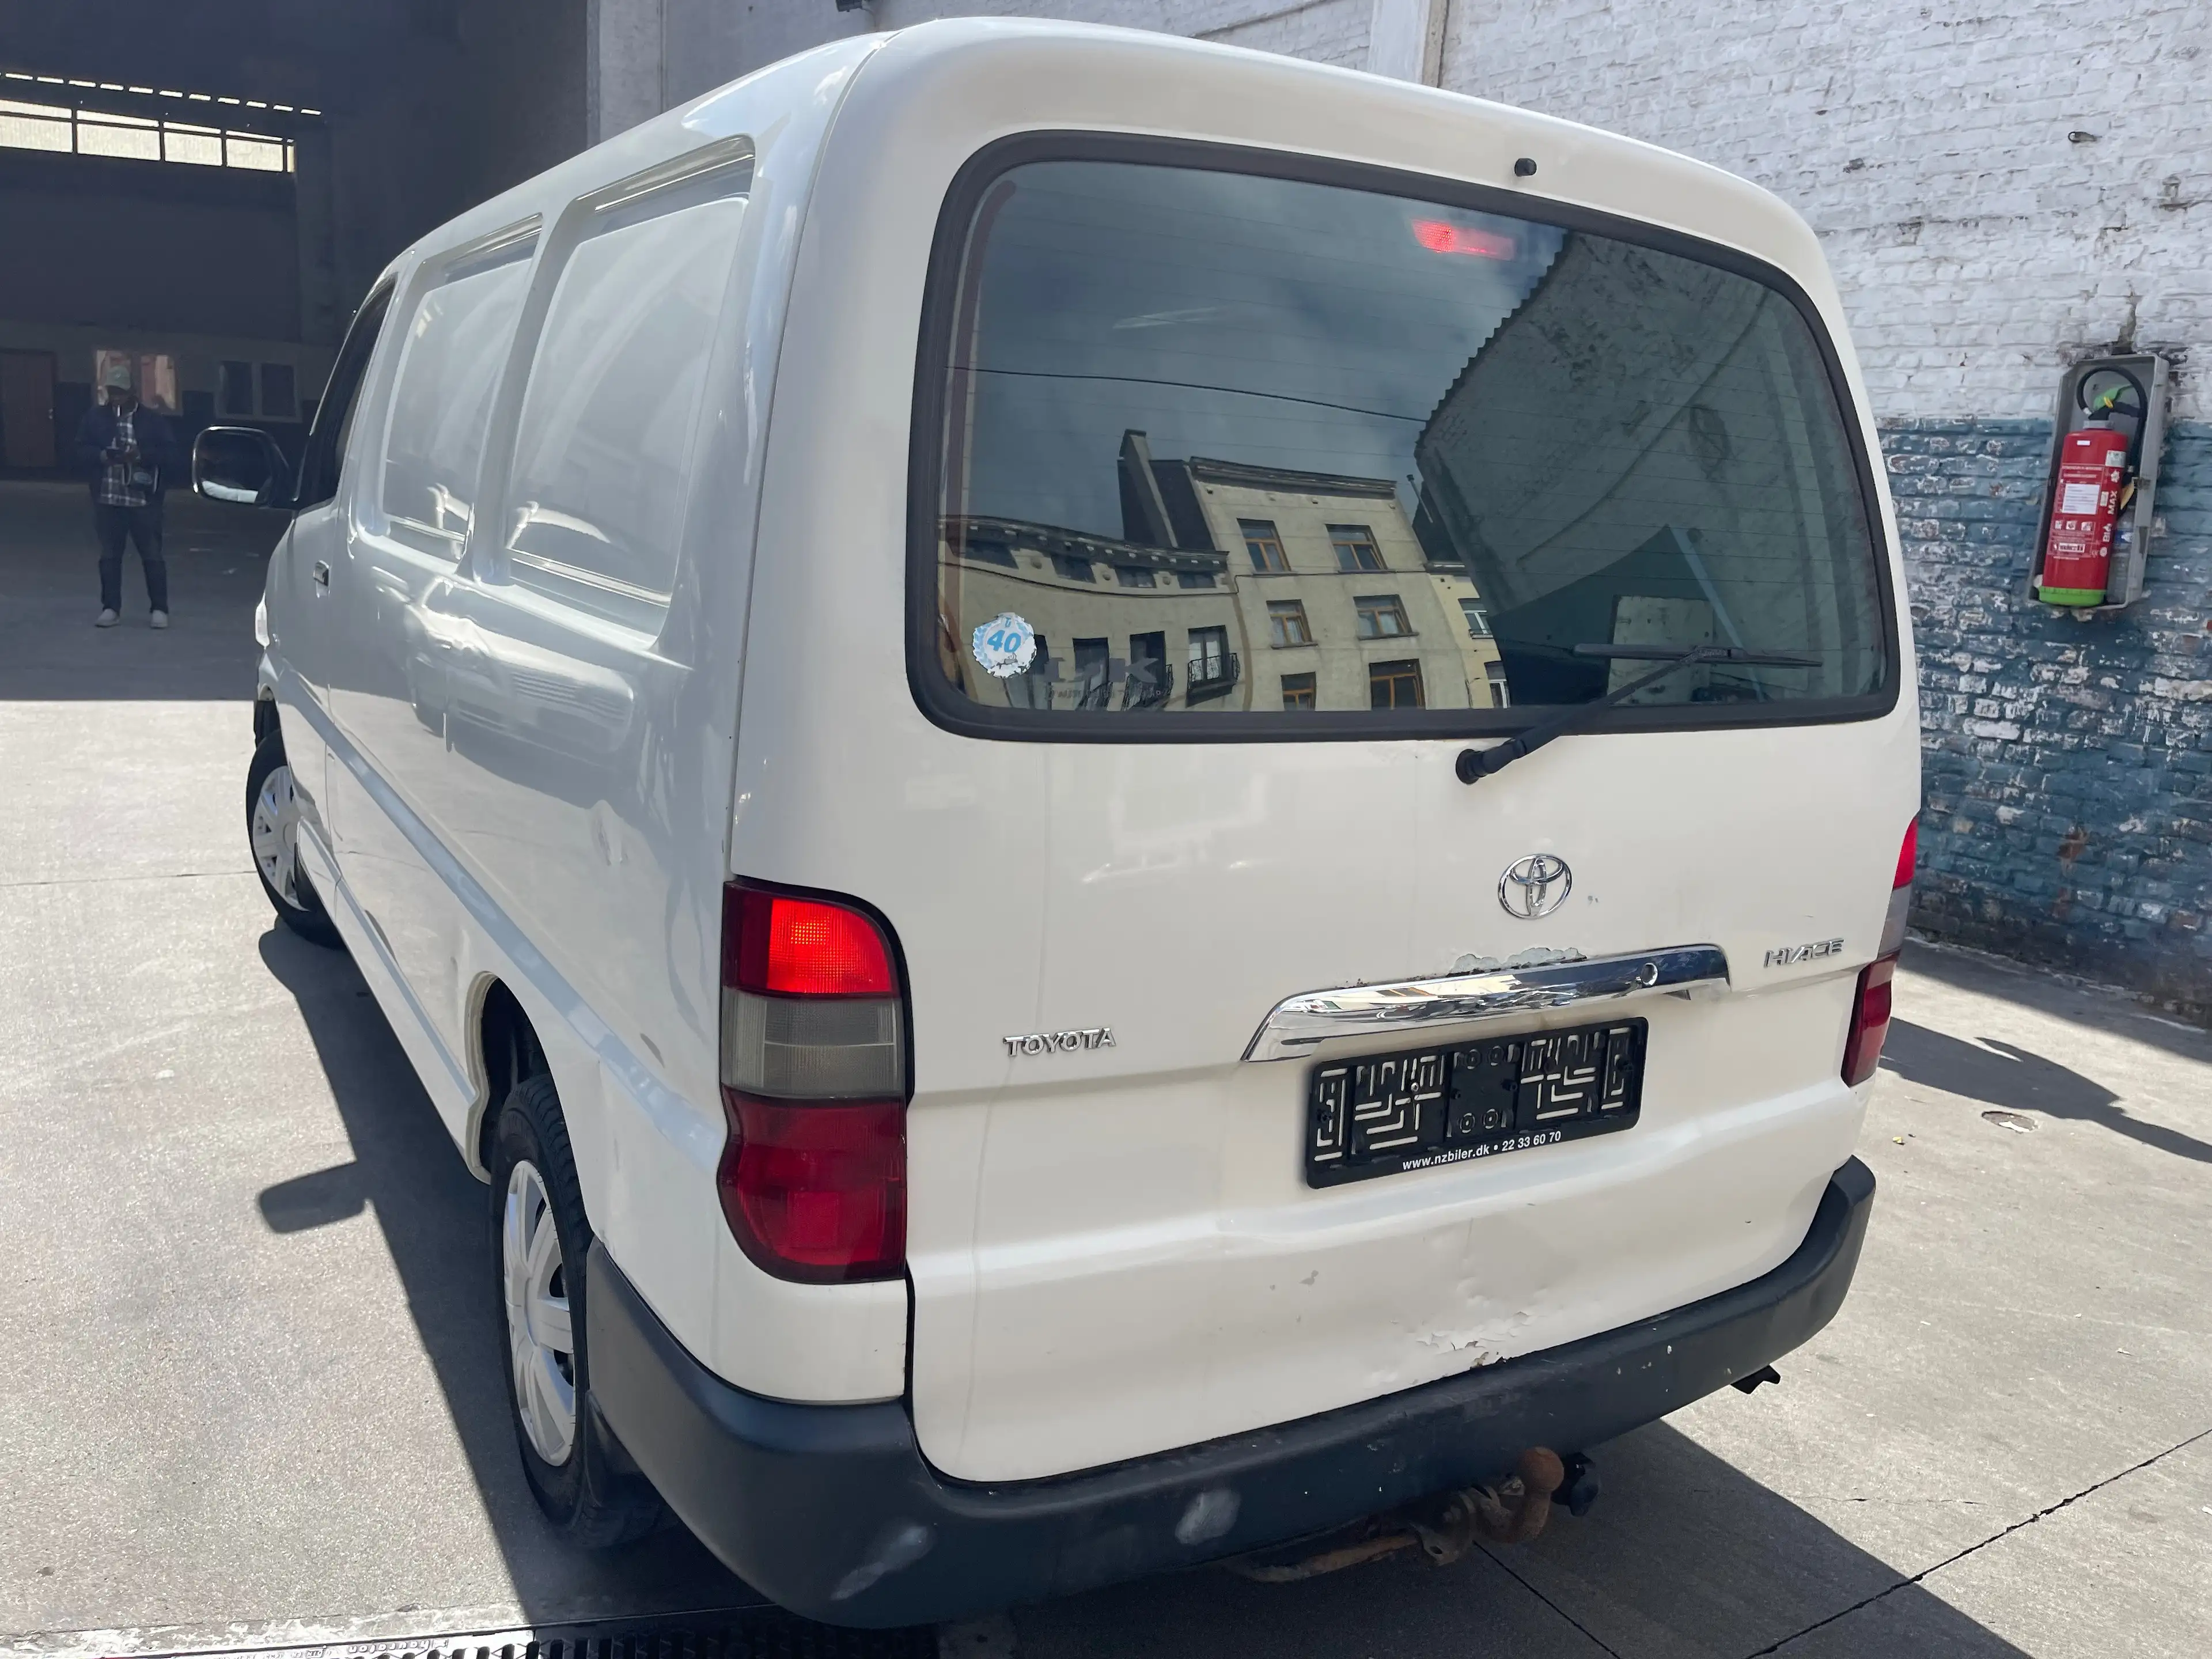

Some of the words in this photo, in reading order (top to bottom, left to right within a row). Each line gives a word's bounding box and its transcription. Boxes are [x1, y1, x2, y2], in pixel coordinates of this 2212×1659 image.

[987, 630, 1021, 653] 40
[1763, 938, 1844, 968] HIACE
[1002, 1027, 1116, 1056] TOYOTA
[1402, 1144, 1490, 1170] www.nzbiler.dk
[1502, 1139, 1515, 1152] 22
[1517, 1136, 1531, 1148] 33
[1533, 1133, 1546, 1146] 60
[1549, 1130, 1562, 1142] 70
